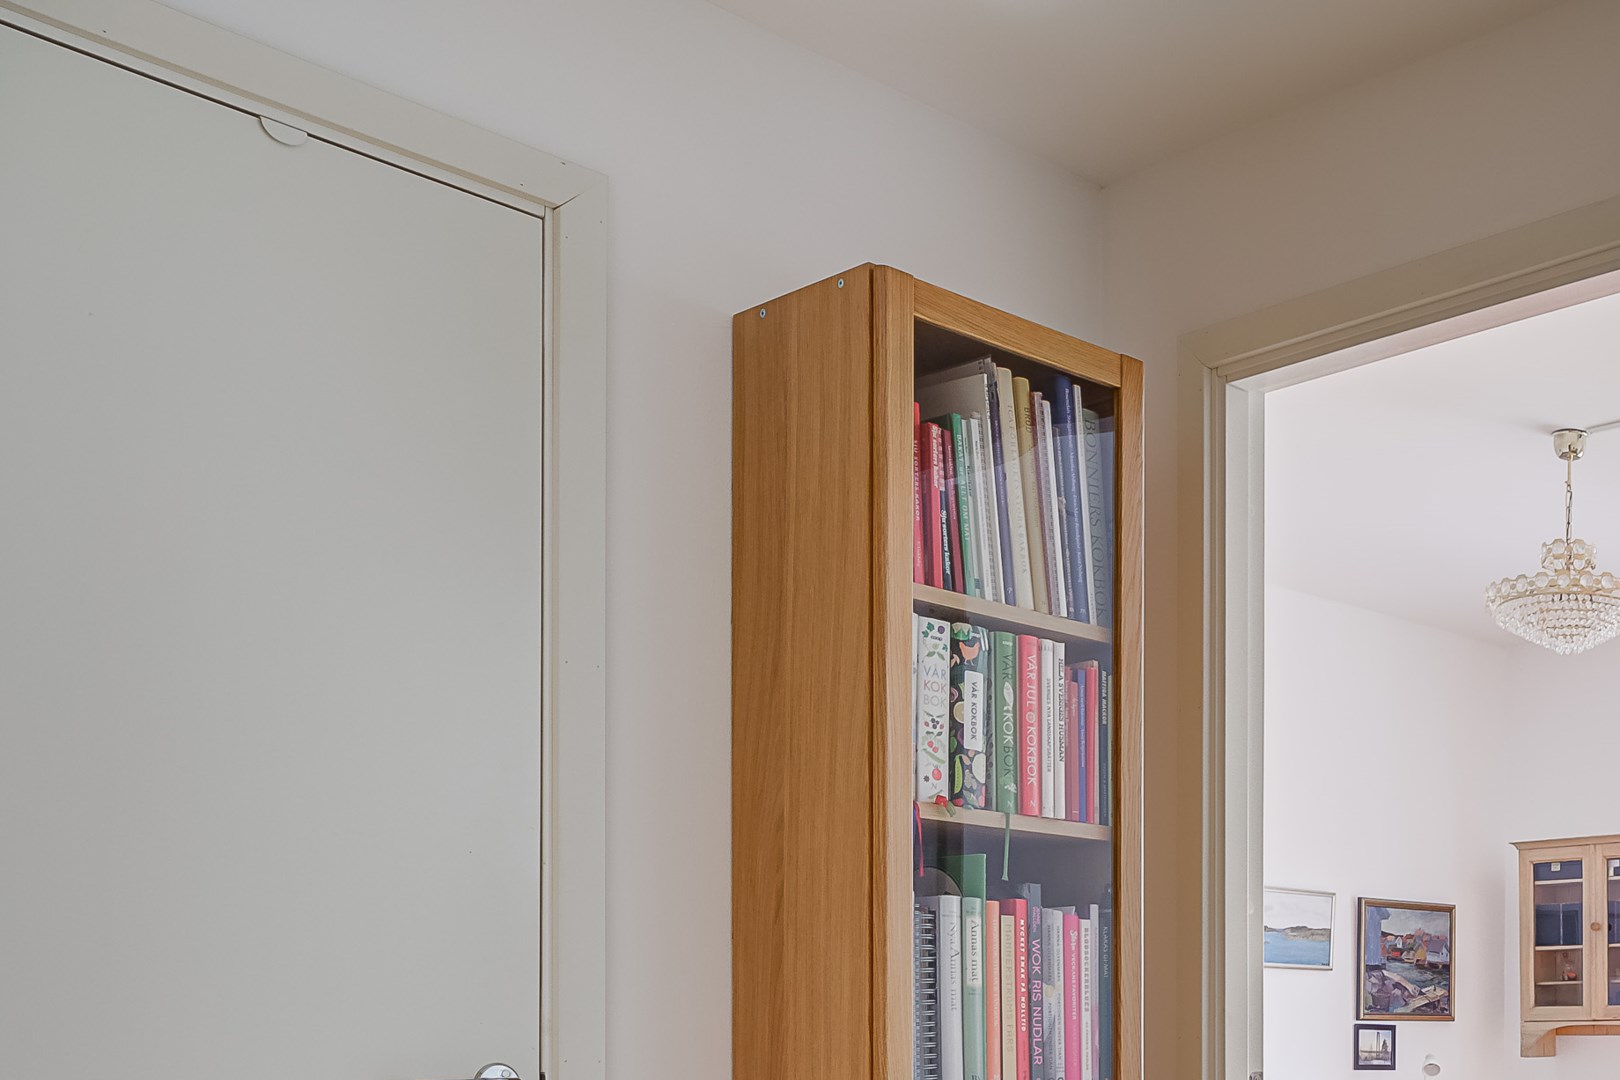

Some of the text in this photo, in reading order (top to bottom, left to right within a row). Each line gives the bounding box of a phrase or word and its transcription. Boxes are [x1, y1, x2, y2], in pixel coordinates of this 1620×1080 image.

[942, 523, 950, 549] sorters
[1085, 420, 1107, 619] BONNIERS KOKBOK
[923, 680, 947, 694] KOK
[923, 694, 947, 708] BOK
[1026, 682, 1037, 707] JUL
[970, 701, 978, 741] KOKBOK
[1003, 712, 1015, 777] KOKBOK
[1027, 726, 1038, 786] KOKBOK
[947, 921, 960, 1012] Nya Annas mat
[970, 919, 980, 984] Annas mat
[1031, 938, 1043, 1065] WOK RIS NUDLAR
